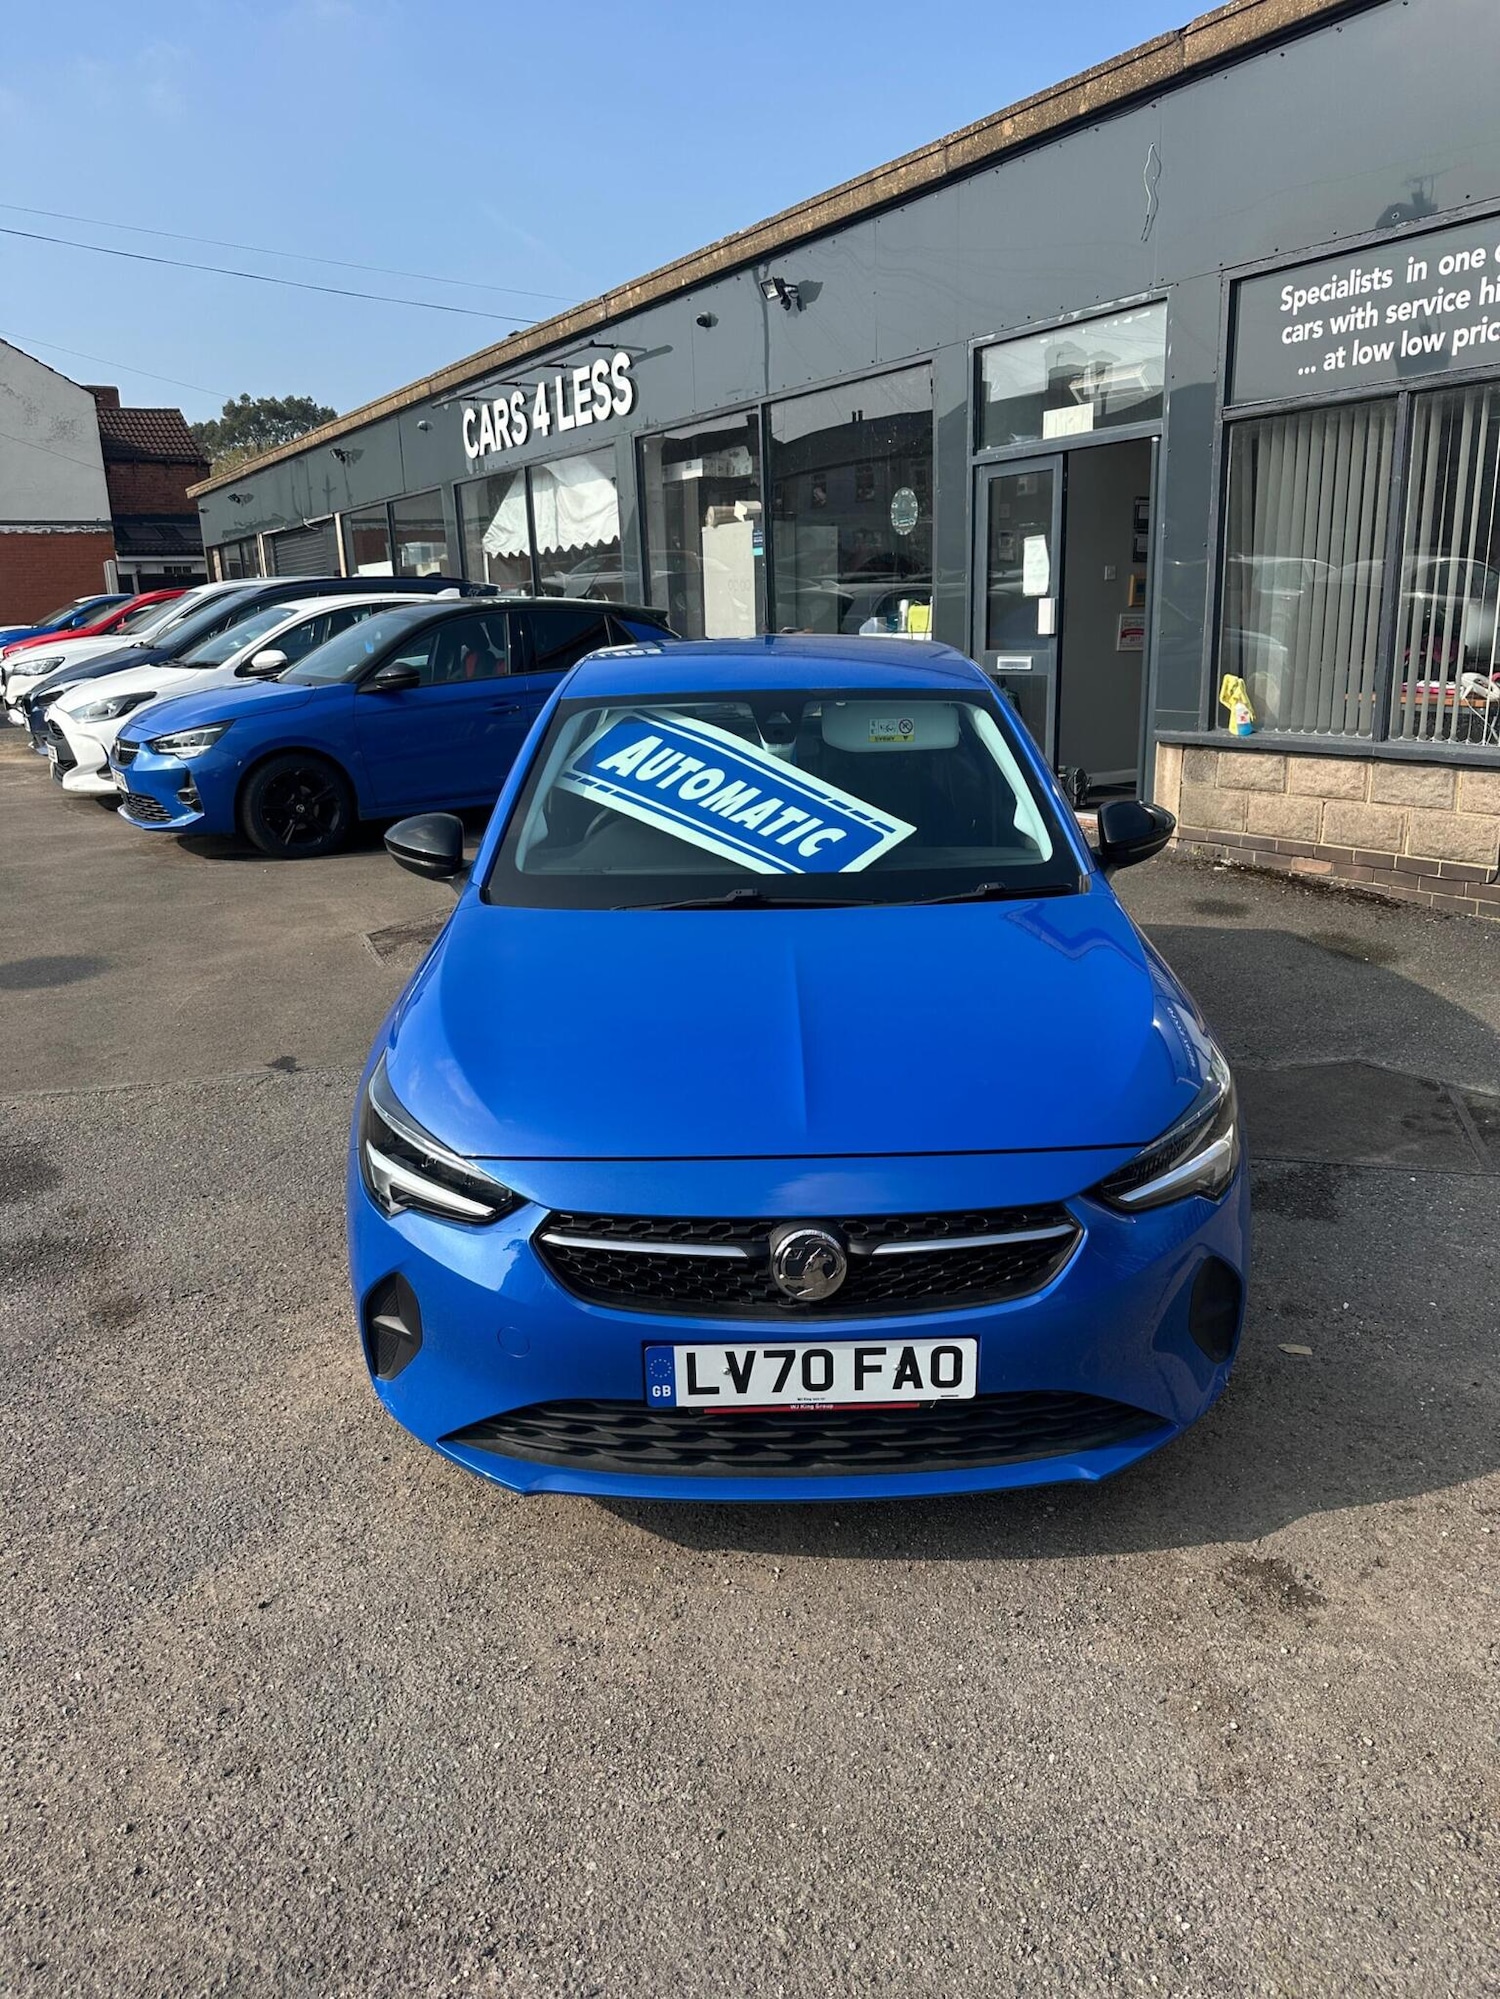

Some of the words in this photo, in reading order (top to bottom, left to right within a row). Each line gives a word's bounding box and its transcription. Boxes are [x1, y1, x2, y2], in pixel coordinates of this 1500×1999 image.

[1280, 266, 1393, 316] Specialists
[1406, 257, 1428, 283] in
[1438, 248, 1487, 275] one
[1281, 317, 1323, 345] cars
[1330, 302, 1378, 335] with
[1385, 287, 1471, 324] service
[1323, 348, 1346, 371] at
[1352, 340, 1395, 366] low
[1400, 330, 1446, 358] low
[1451, 316, 1500, 356] pric
[462, 390, 528, 460] CARS
[532, 382, 551, 437] 4
[554, 352, 634, 432] LESS
[596, 735, 848, 858] AUTOMATIC
[652, 1385, 672, 1398] GB
[686, 1348, 834, 1396] LV70
